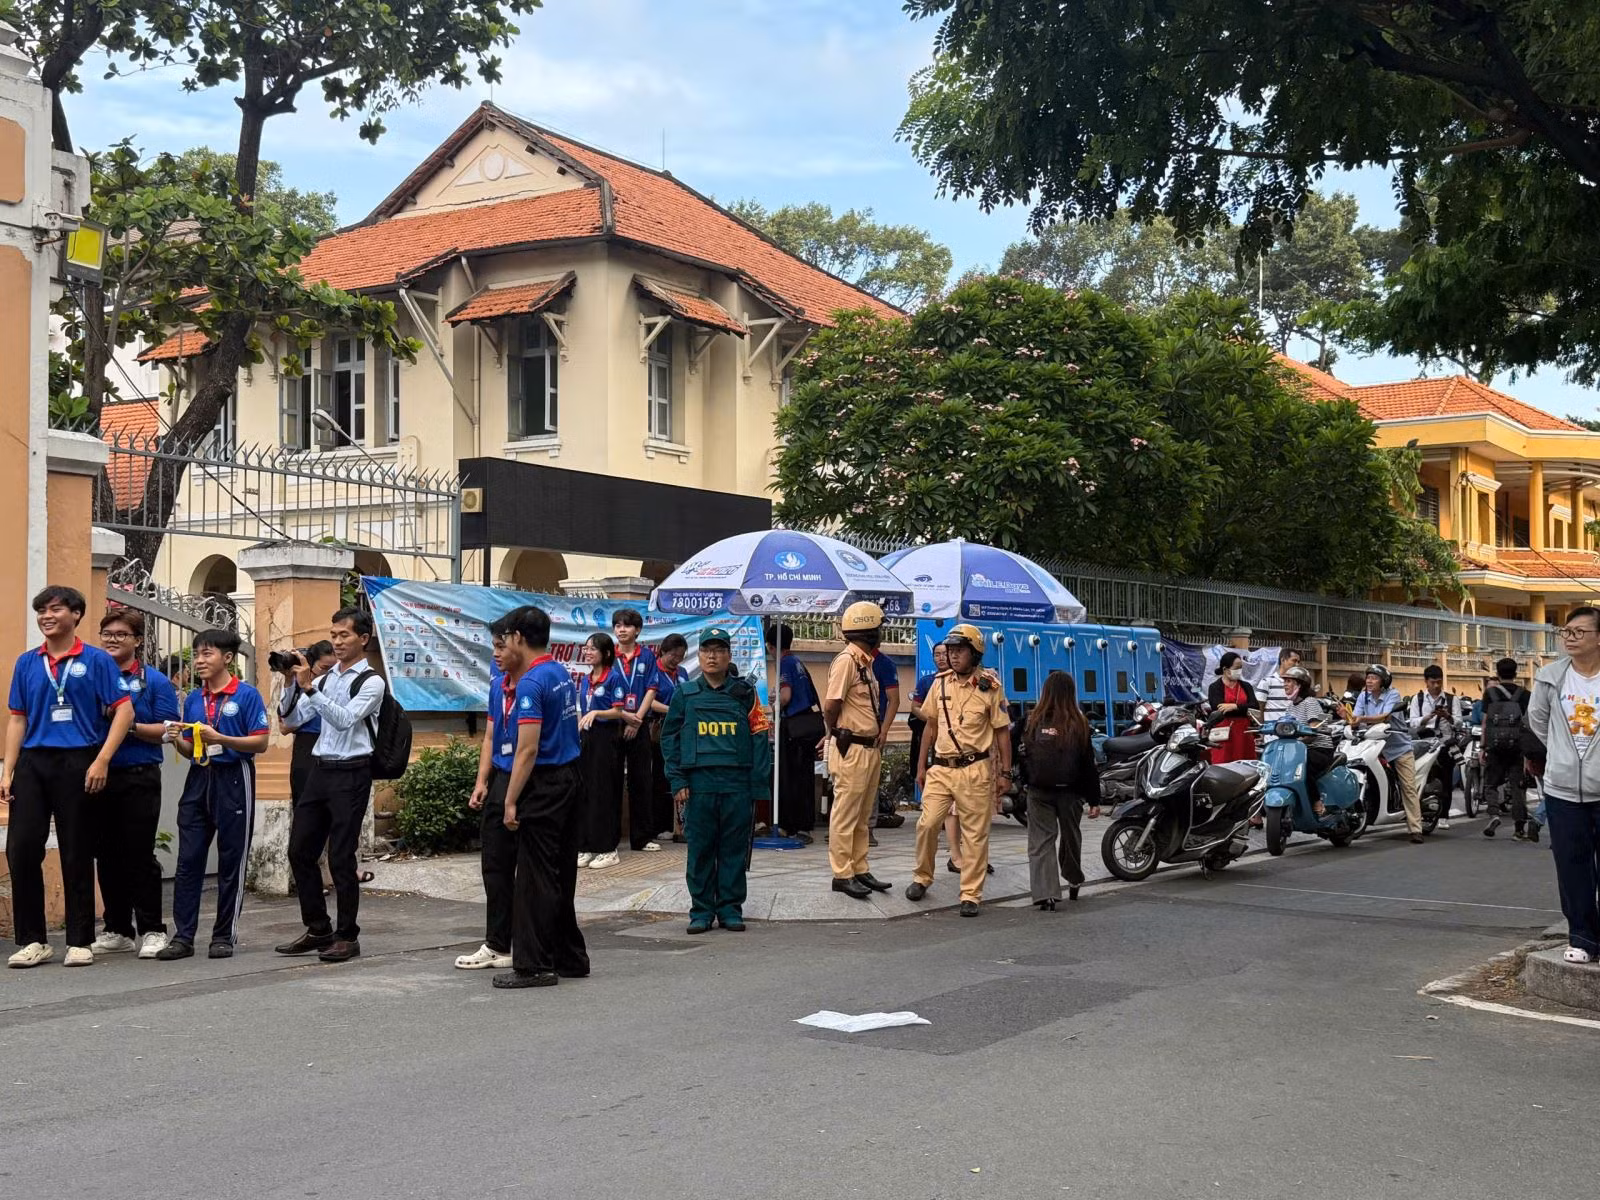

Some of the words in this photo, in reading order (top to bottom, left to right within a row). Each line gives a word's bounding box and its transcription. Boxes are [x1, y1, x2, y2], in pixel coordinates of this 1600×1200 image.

[802, 573, 822, 581] MINH
[672, 597, 723, 609] 18001568
[853, 616, 875, 624] CSGT
[698, 721, 737, 737] DQTT
